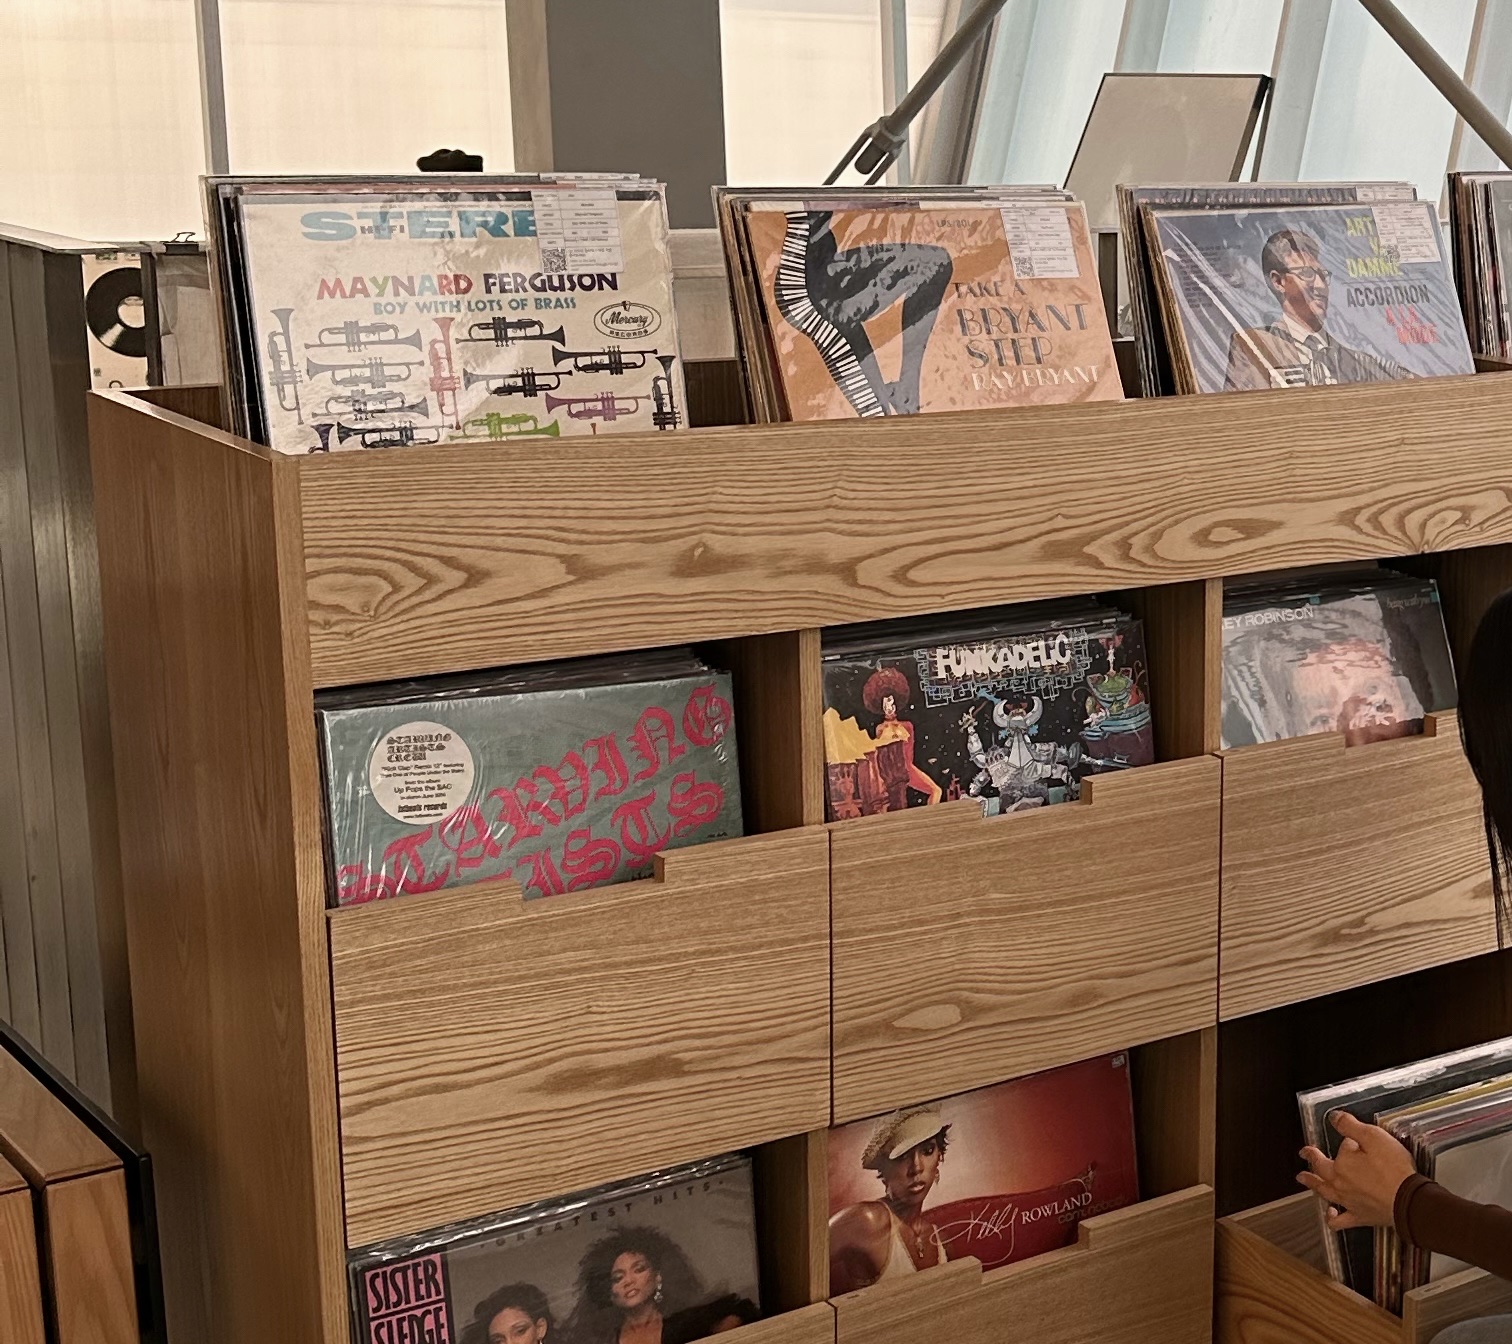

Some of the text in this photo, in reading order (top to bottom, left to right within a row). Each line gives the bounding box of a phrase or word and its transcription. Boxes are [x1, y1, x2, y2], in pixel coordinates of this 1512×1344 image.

[316, 272, 619, 300] MAYNARD FERGUSON
[951, 281, 1027, 299] TAKE A
[1346, 284, 1431, 308] ACCORDION
[373, 296, 577, 316] BOY WITH LOTS OF BRASS
[605, 311, 649, 328] Mercury
[956, 302, 1089, 337] BRYANT
[965, 336, 1053, 369] STEP
[971, 364, 1100, 391] RAY BRYANT
[1222, 606, 1315, 630] EY ROBINSON
[936, 634, 1072, 679] FUNKADELIC
[495, 1184, 711, 1247] GREATEST HITS
[1020, 1192, 1093, 1225] ROWLAND
[369, 1258, 442, 1314] SISTER
